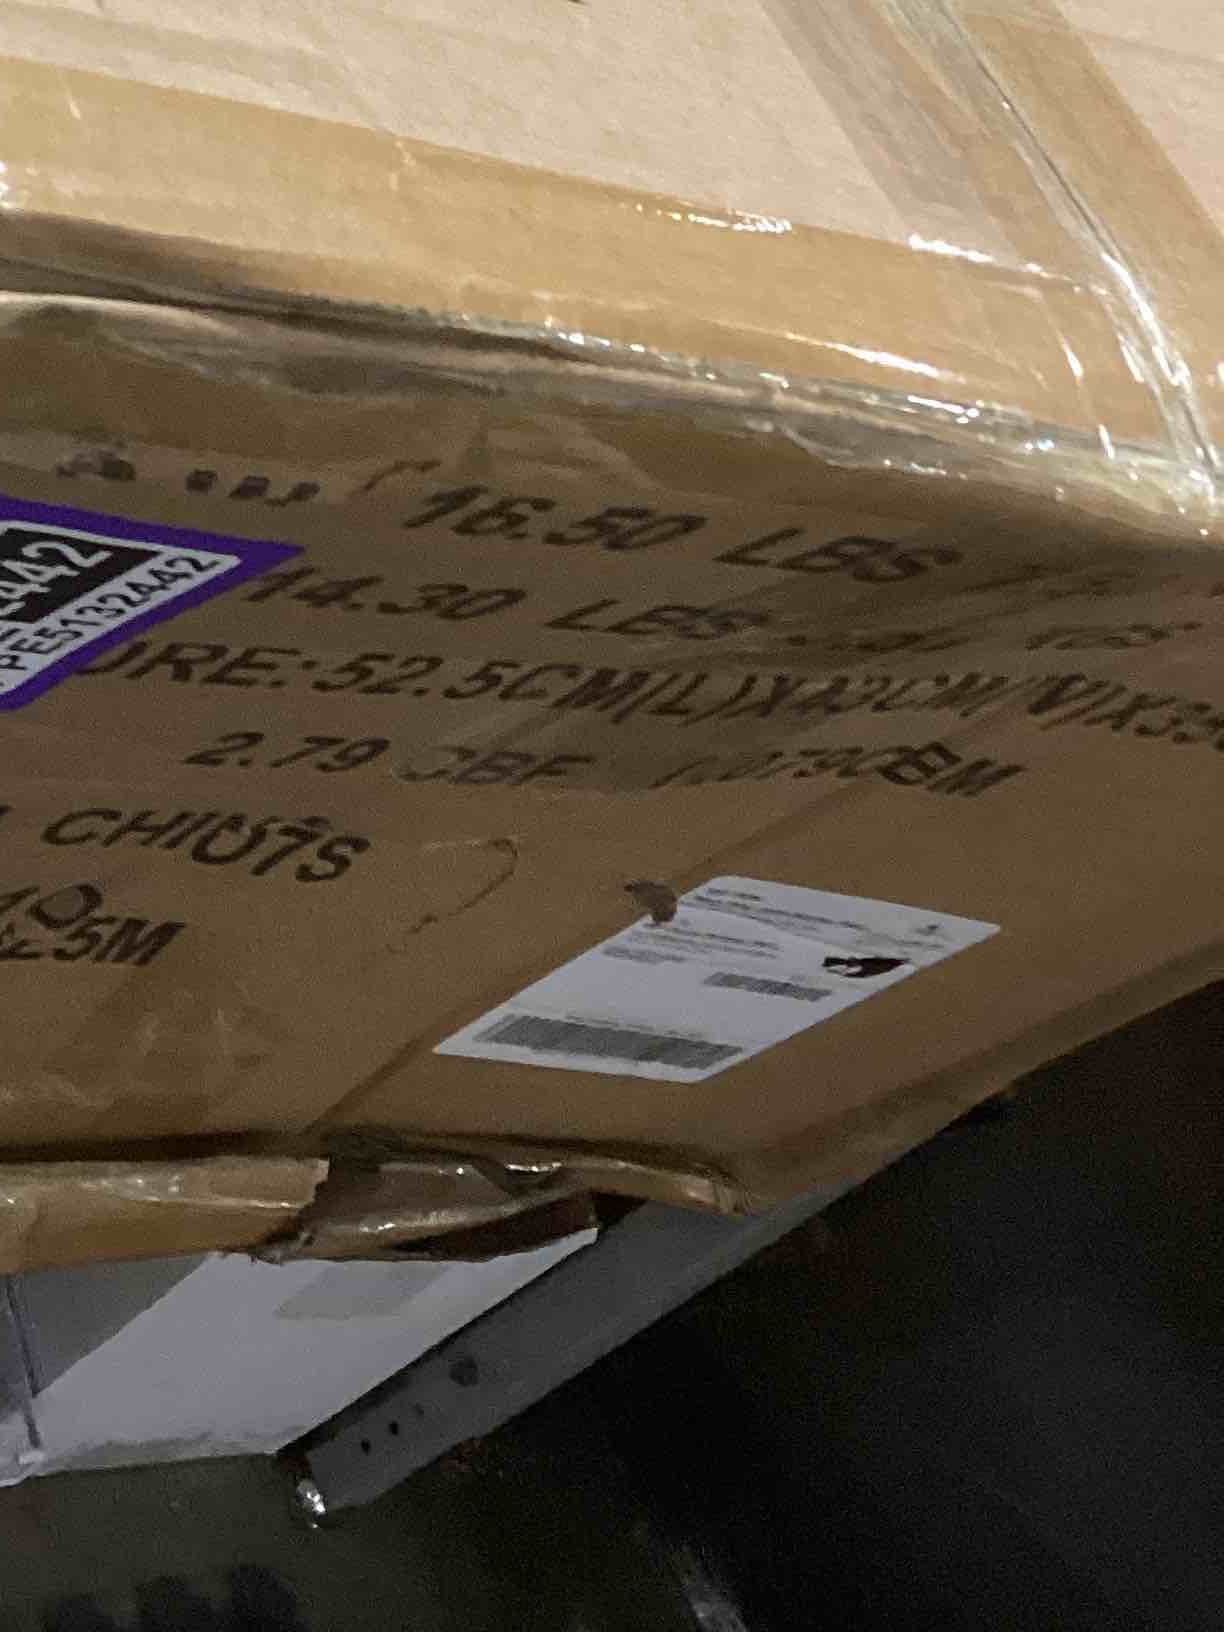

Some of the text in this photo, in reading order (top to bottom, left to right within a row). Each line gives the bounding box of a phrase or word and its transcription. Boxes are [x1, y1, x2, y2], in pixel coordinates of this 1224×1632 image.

[403, 484, 709, 552] 16.50
[713, 527, 964, 583] LBS
[243, 568, 527, 621] 14.30
[182, 730, 392, 773] 2.79
